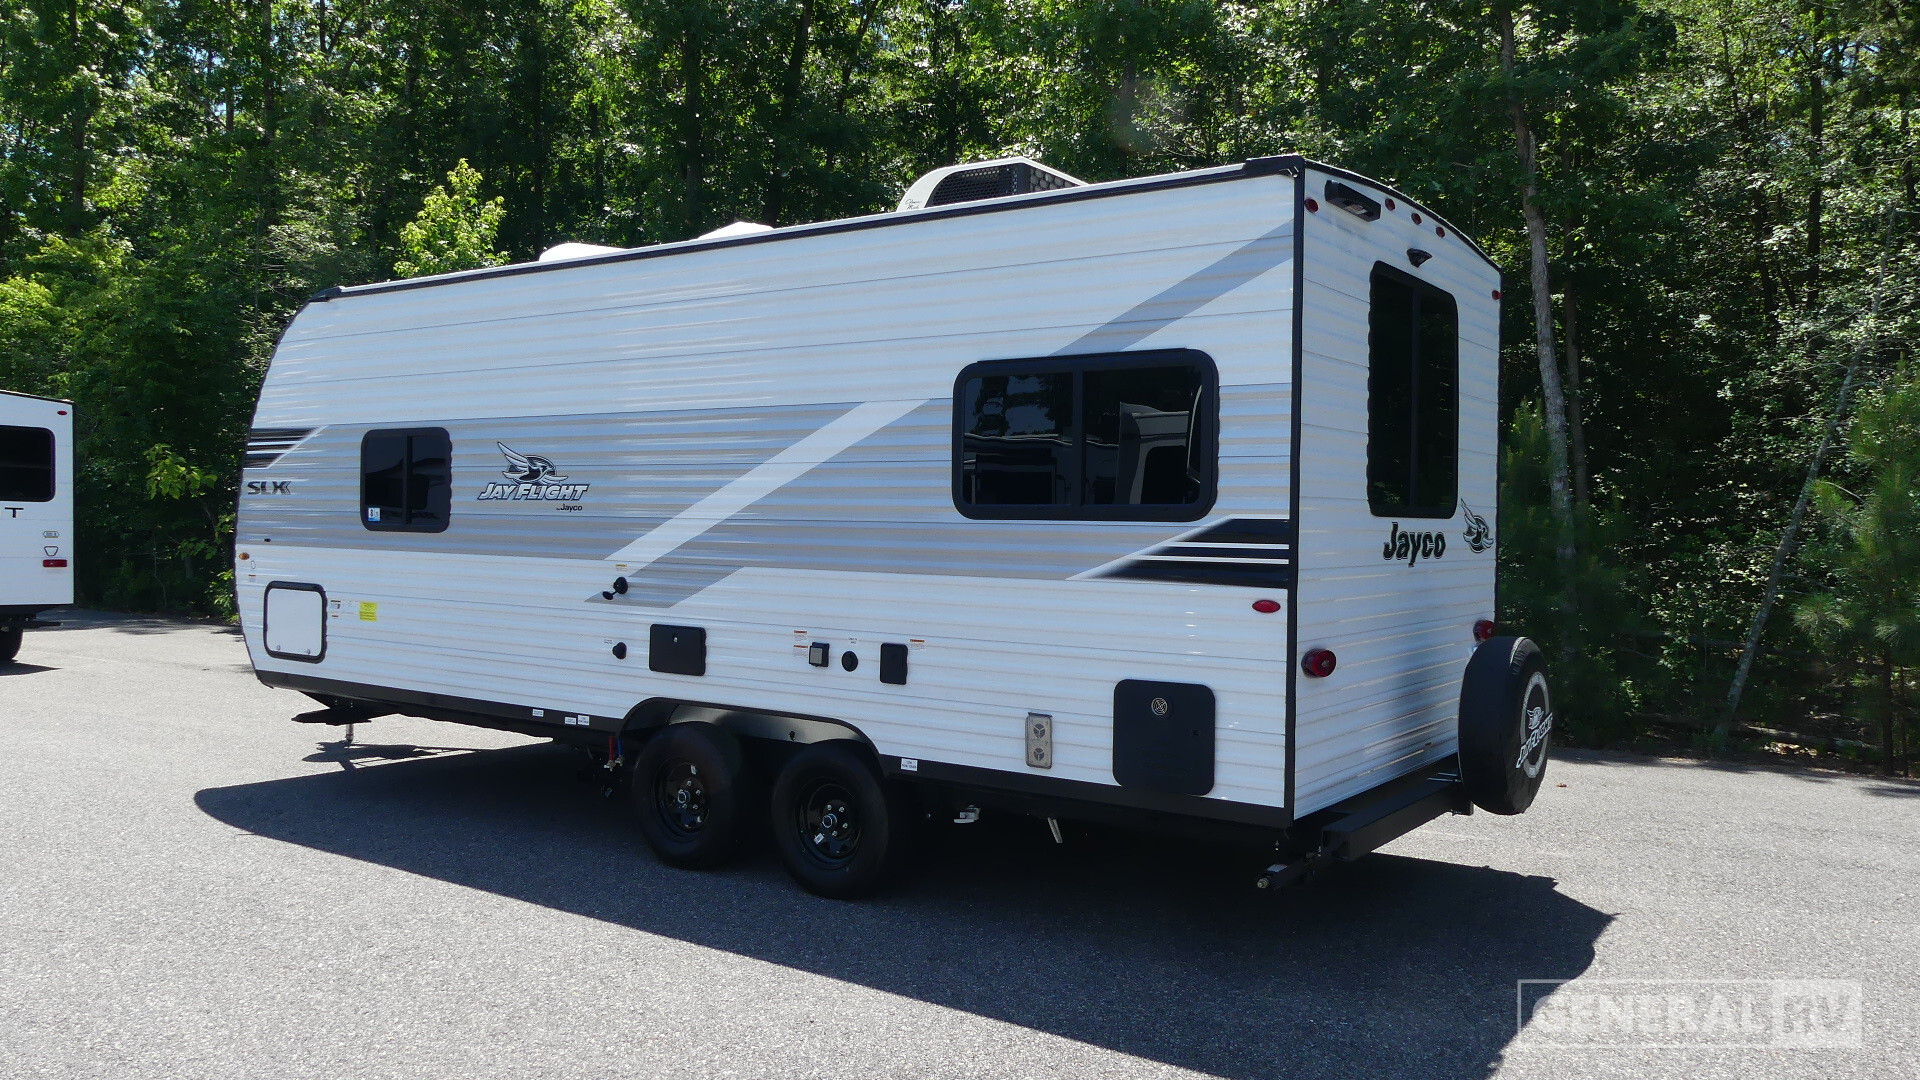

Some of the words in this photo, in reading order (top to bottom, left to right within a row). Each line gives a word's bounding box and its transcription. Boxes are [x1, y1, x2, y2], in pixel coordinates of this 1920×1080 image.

[478, 482, 516, 500] JAY
[513, 483, 590, 501] FLIGHT
[560, 503, 583, 512] Jayco
[1383, 521, 1446, 568] Jayco
